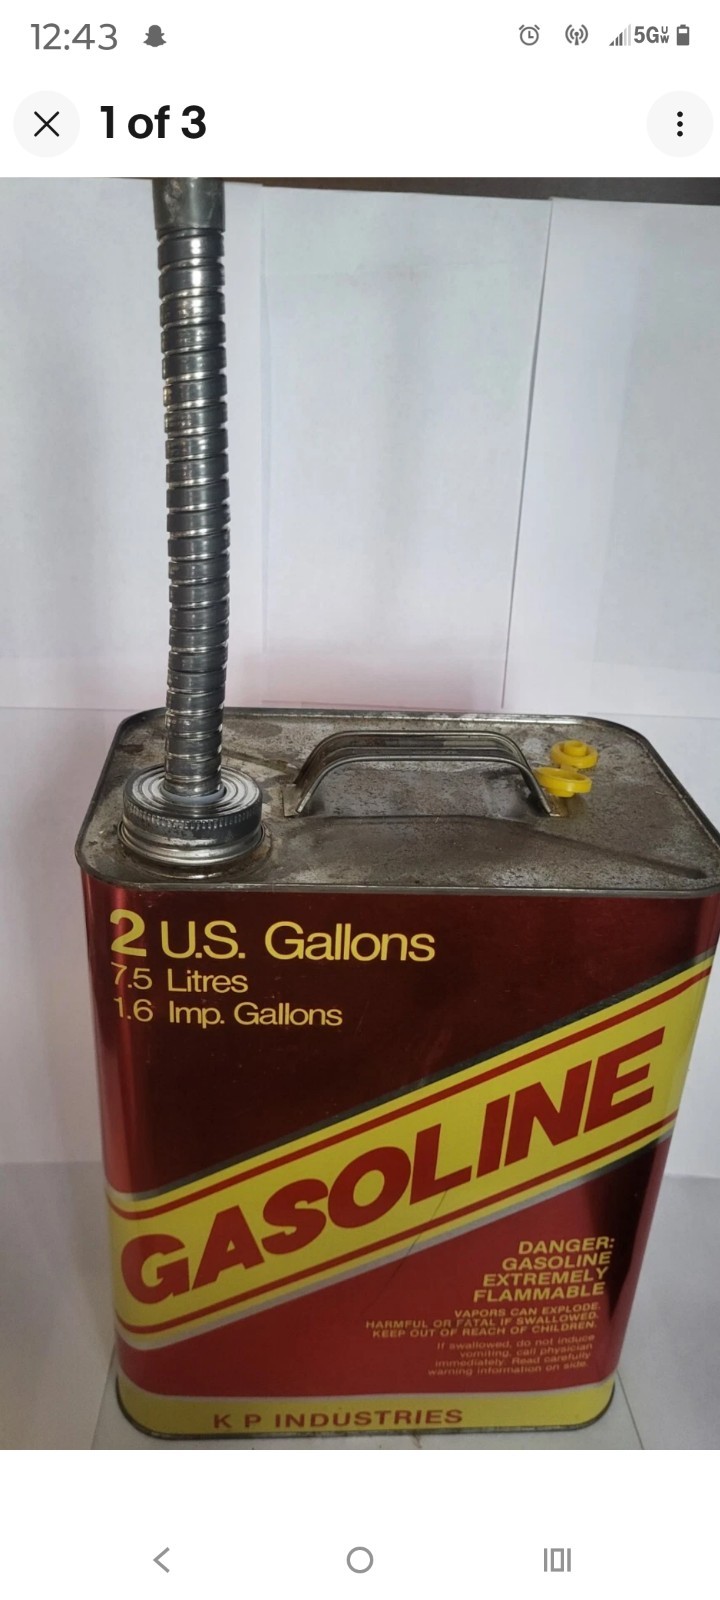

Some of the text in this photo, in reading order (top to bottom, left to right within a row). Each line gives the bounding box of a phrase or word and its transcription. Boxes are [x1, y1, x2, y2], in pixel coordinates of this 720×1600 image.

[110, 909, 435, 961] 2 U.S. Gallons
[110, 962, 248, 993] 7.5 Litres
[113, 997, 342, 1028] 1.6 Imp. Gallons
[121, 1027, 665, 1304] GASOLINE
[519, 1236, 614, 1254] DANGER:
[502, 1252, 611, 1271] GASOLINE
[483, 1267, 608, 1287] EXTREMELY
[473, 1282, 605, 1302] FLAMMABLE
[455, 1302, 600, 1318] VAPORS CAN EXPLODE.
[366, 1311, 598, 1329] HARMFUL OR FATAL IF SWALLOWED.
[373, 1321, 597, 1338] KEEP OUT OF REACH OF CHILDREN.
[536, 1338, 553, 1346] not
[558, 1334, 595, 1345] induce
[512, 1356, 540, 1364] Read
[544, 1352, 591, 1365] carefully
[516, 1348, 536, 1356] call
[540, 1343, 592, 1357] physician
[428, 1368, 473, 1376] warning
[477, 1366, 541, 1374] information
[213, 1409, 463, 1429] K P INDUSTRIES
